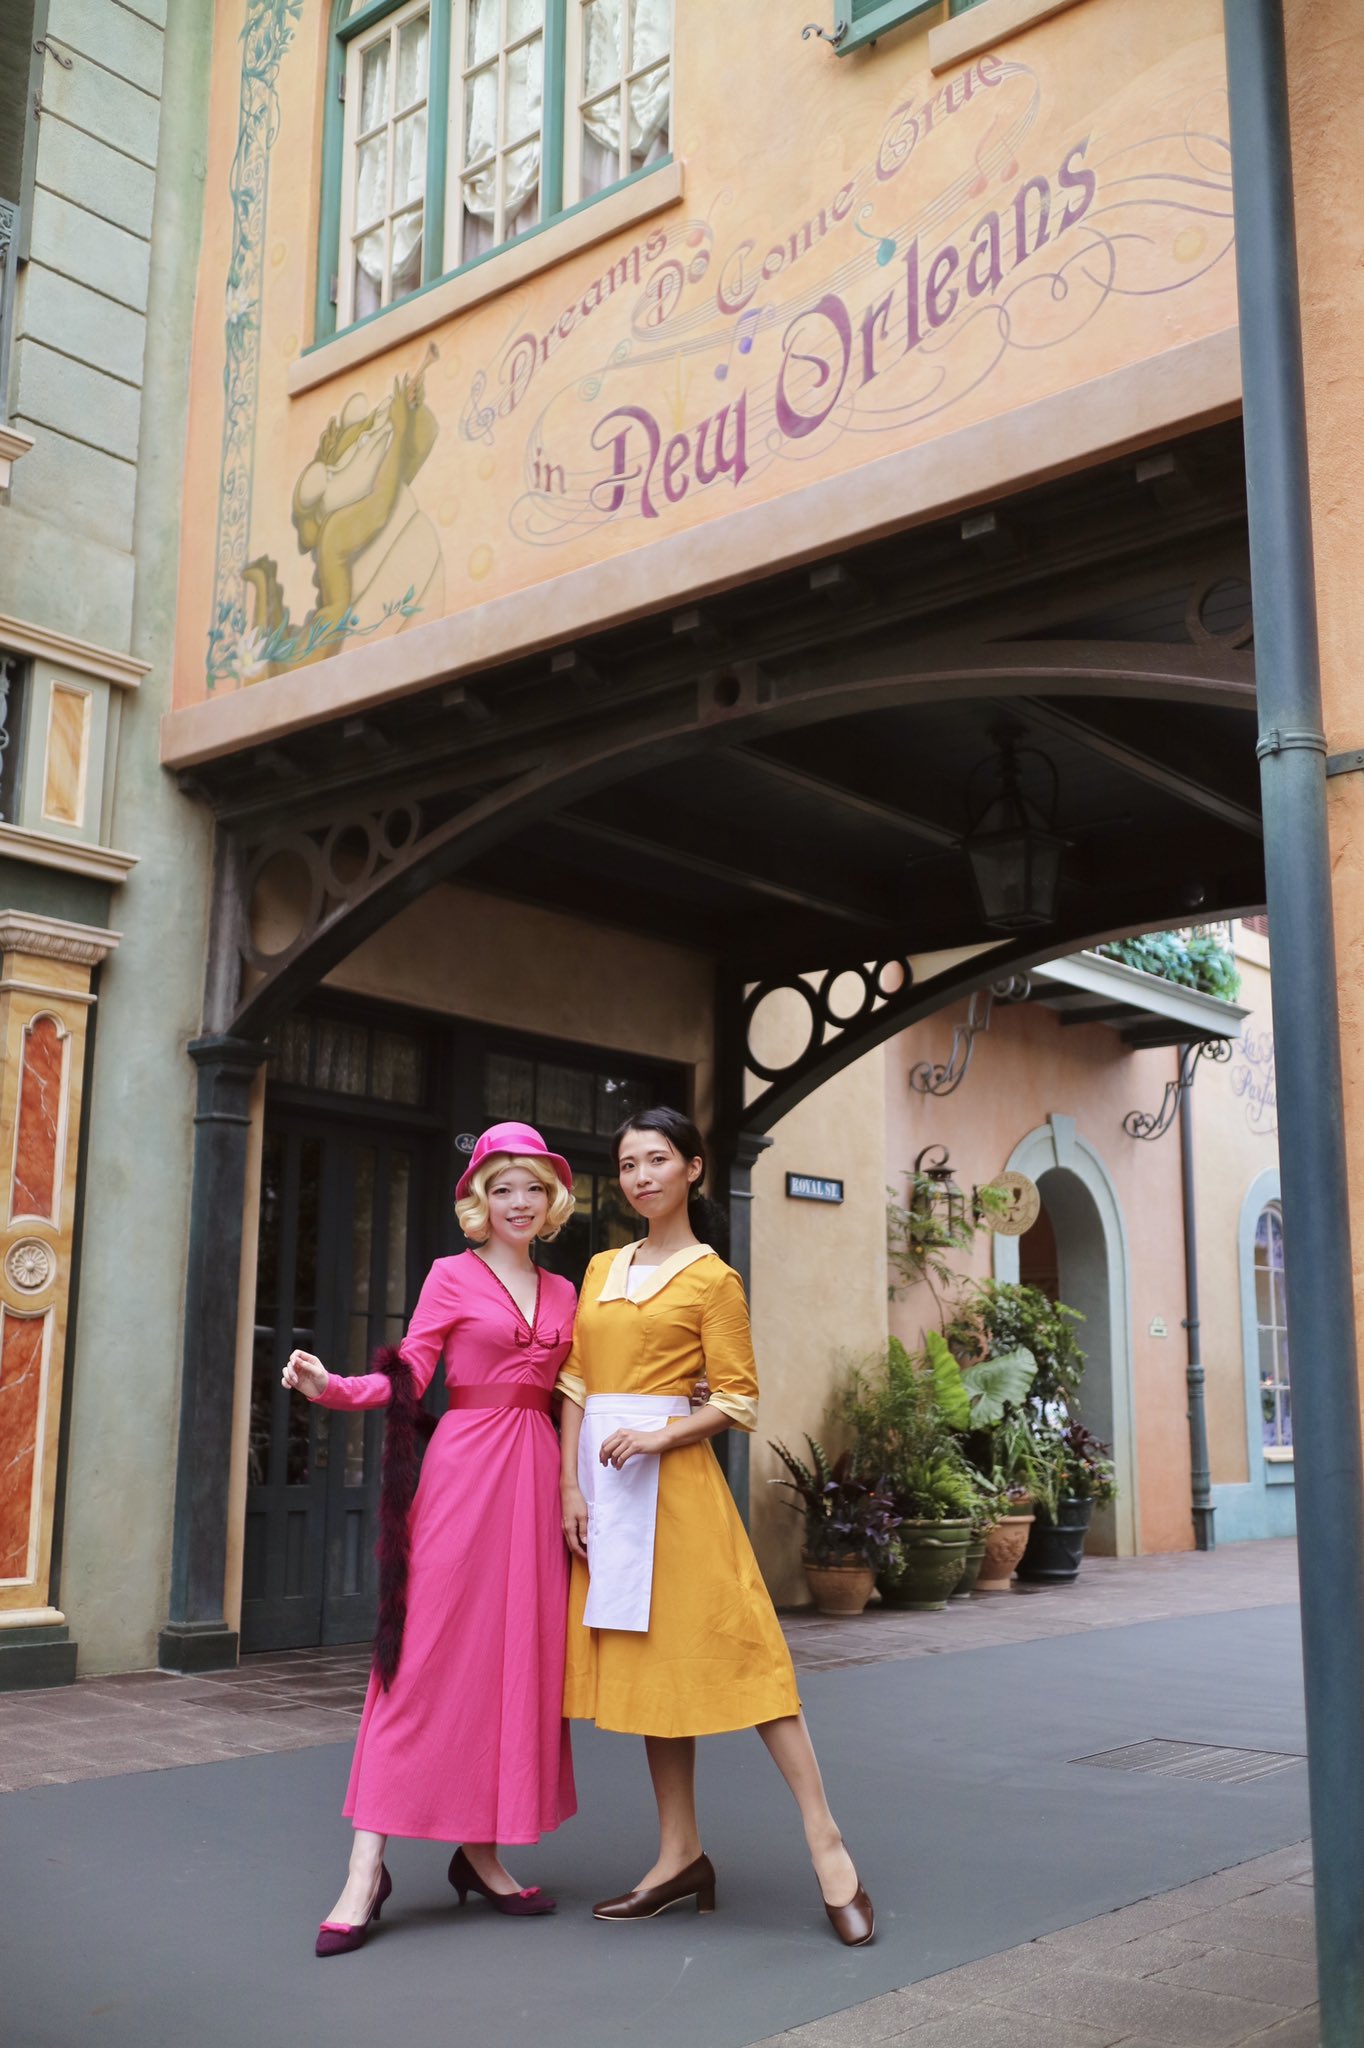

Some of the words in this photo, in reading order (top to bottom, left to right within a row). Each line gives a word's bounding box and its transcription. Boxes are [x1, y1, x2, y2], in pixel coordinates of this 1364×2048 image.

[498, 227, 668, 418] Dreams
[646, 249, 710, 328] Do
[717, 181, 855, 315] Come
[876, 54, 1004, 181] True
[534, 447, 567, 494] in
[590, 386, 750, 518] New
[775, 134, 1097, 439] Orleans
[791, 1177, 824, 1196] ROYAL
